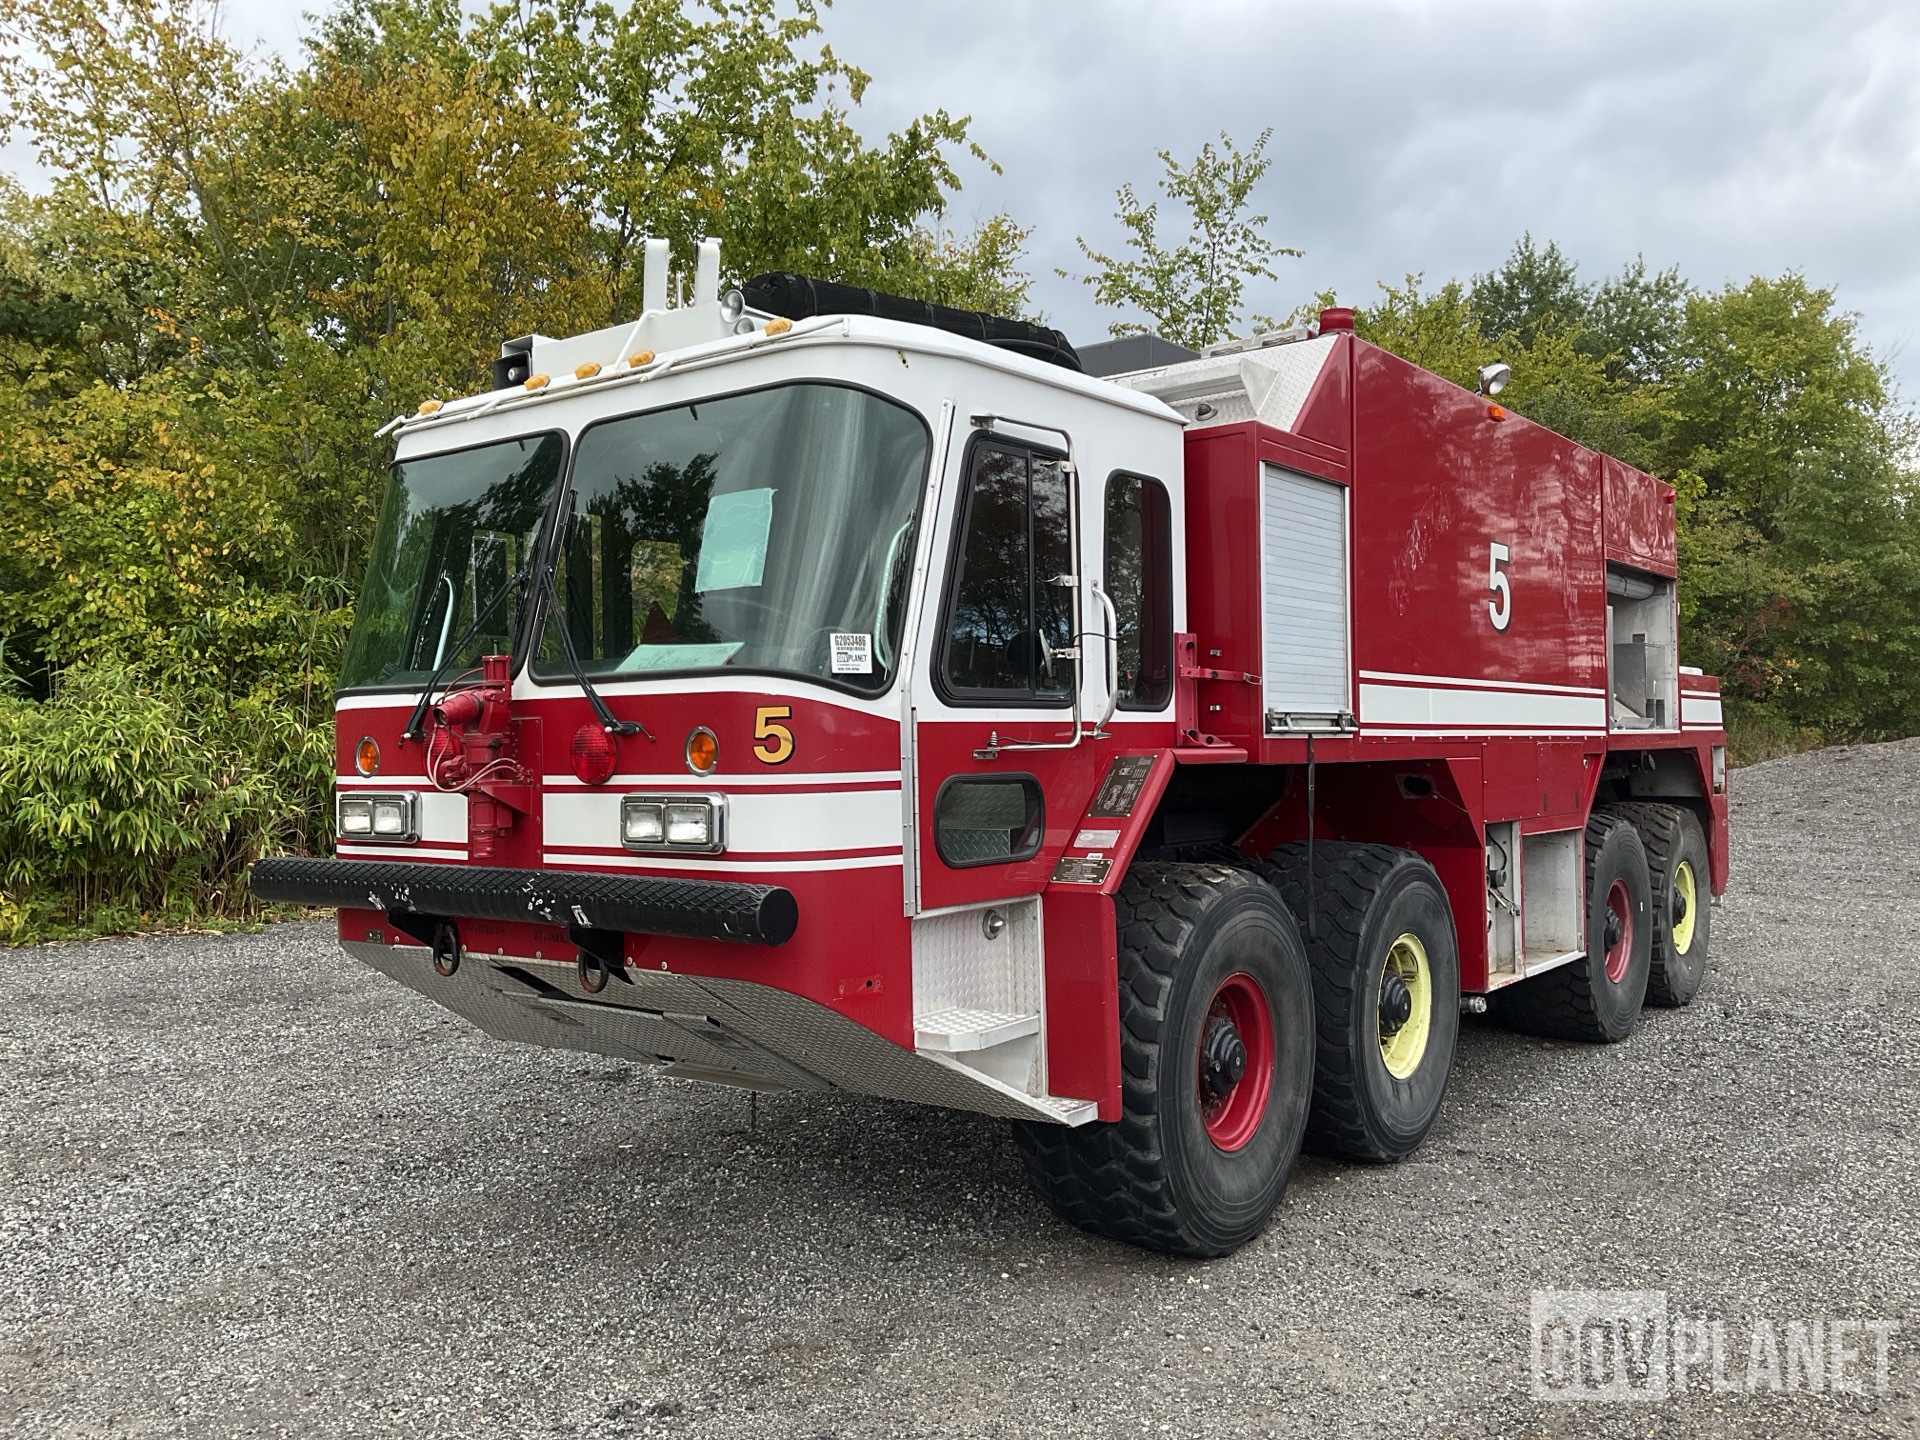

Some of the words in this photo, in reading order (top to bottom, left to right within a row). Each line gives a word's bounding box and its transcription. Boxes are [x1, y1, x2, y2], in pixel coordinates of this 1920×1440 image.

[1488, 541, 1512, 634] 5
[834, 634, 867, 646] G2053486
[753, 705, 795, 765] 5
